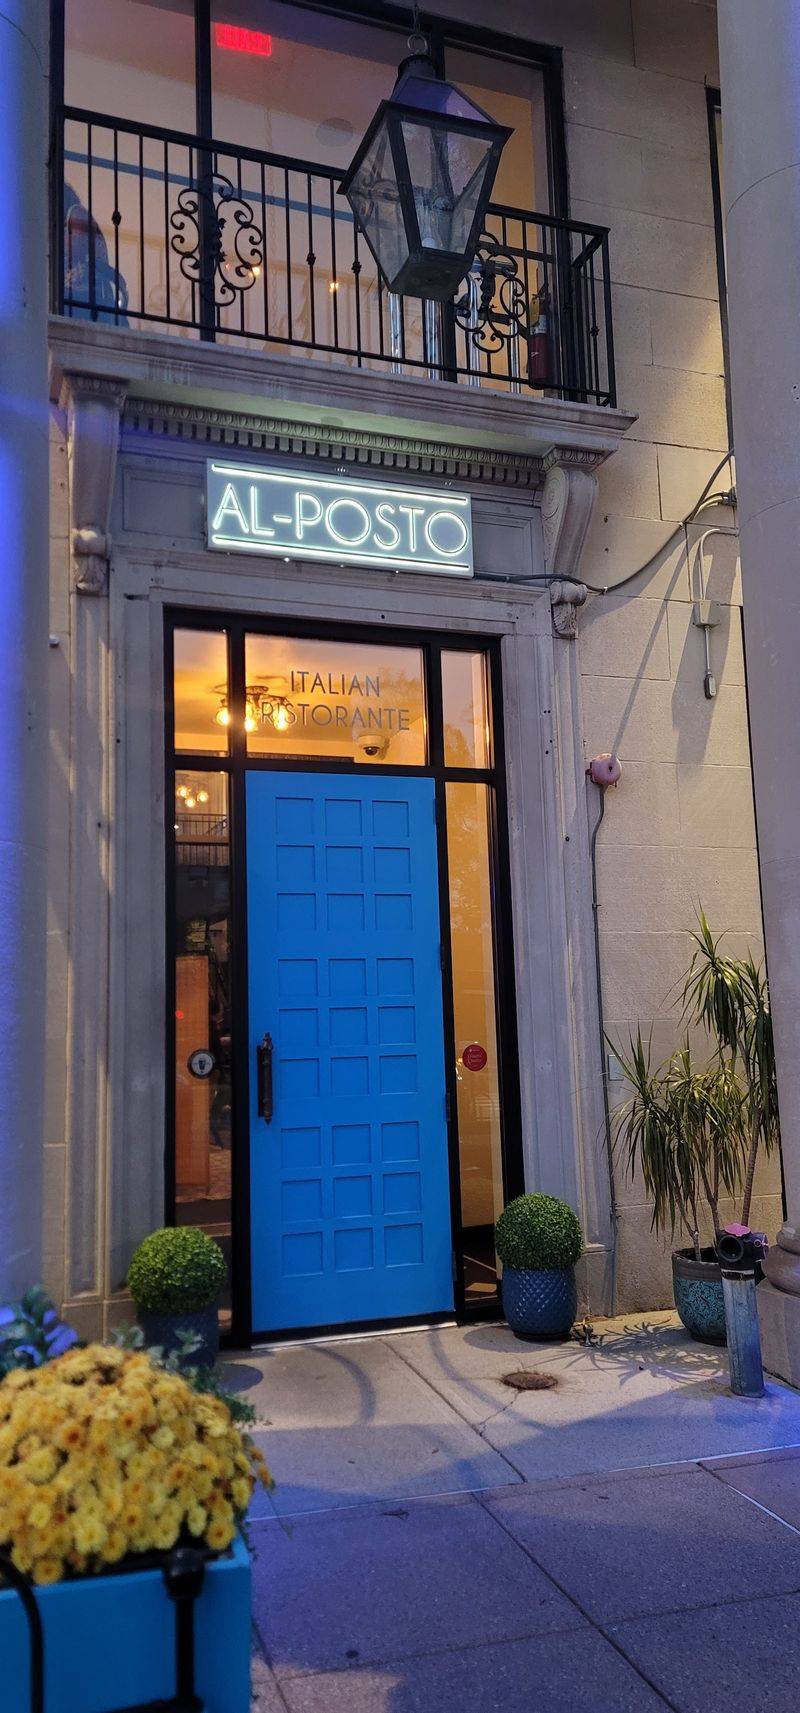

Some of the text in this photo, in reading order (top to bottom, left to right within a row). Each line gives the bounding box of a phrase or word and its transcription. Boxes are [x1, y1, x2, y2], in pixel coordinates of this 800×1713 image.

[212, 482, 469, 557] AL-POSTO
[290, 670, 380, 697] ITALIAN
[261, 701, 410, 731] RISTORANTE
